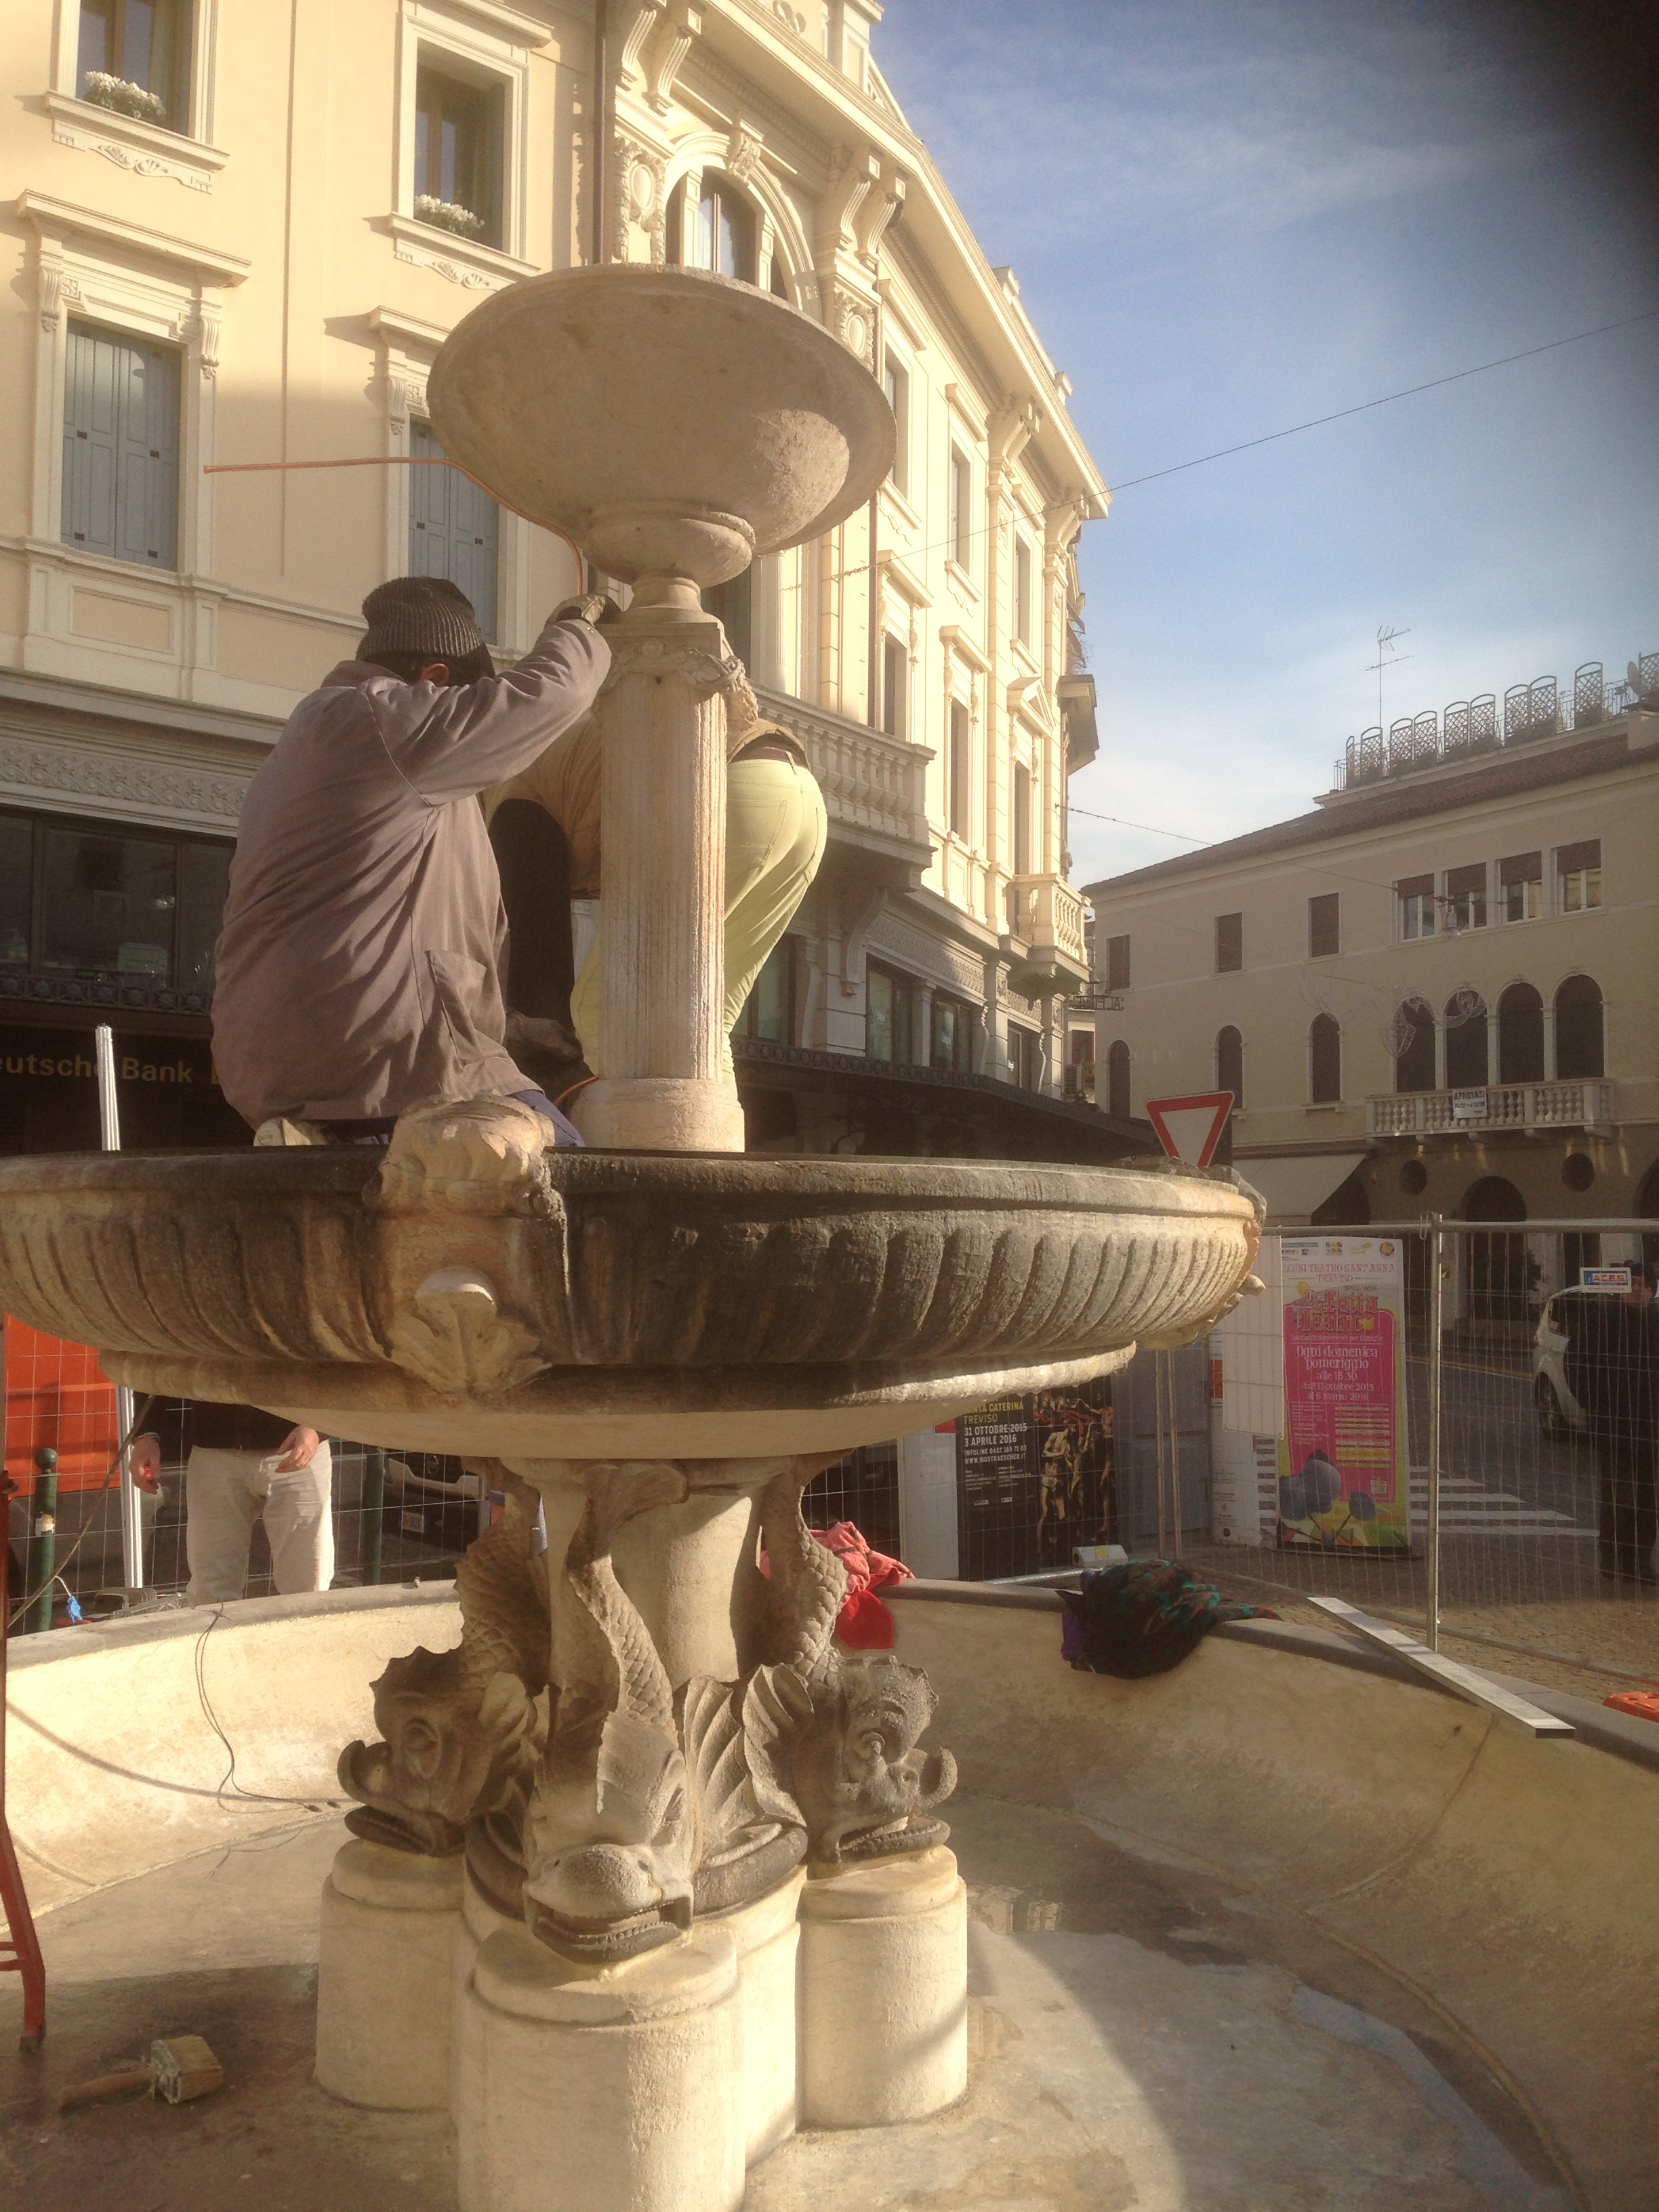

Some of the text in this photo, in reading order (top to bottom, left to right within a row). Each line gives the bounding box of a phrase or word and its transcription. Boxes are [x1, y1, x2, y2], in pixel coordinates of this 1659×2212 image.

[0, 1053, 194, 1084] utsch Bank
[1454, 1090, 1485, 1100] AFFITTASI
[1309, 1264, 1342, 1273] TEATRO
[1317, 1273, 1353, 1283] TREVISO
[1324, 1290, 1378, 1314] Fetta
[1298, 1310, 1364, 1332] Teatro
[1296, 1345, 1378, 1358] Ogni domenica
[1305, 1357, 1369, 1371] pomeriggio
[1317, 1370, 1332, 1380] alle
[1326, 1382, 1353, 1391] ottobre
[1355, 1382, 1374, 1391] 2015
[1307, 1391, 1314, 1400] al
[1323, 1393, 1347, 1401] marzo
[1349, 1392, 1369, 1401] 2016
[988, 1401, 1023, 1412] CATERINA
[963, 1414, 998, 1425] TREVISO
[964, 1422, 1027, 1436] 31 OTTOBRE 2015
[964, 1434, 1017, 1447] 3 APRILE 2016
[964, 1448, 988, 1456] INFOLINE
